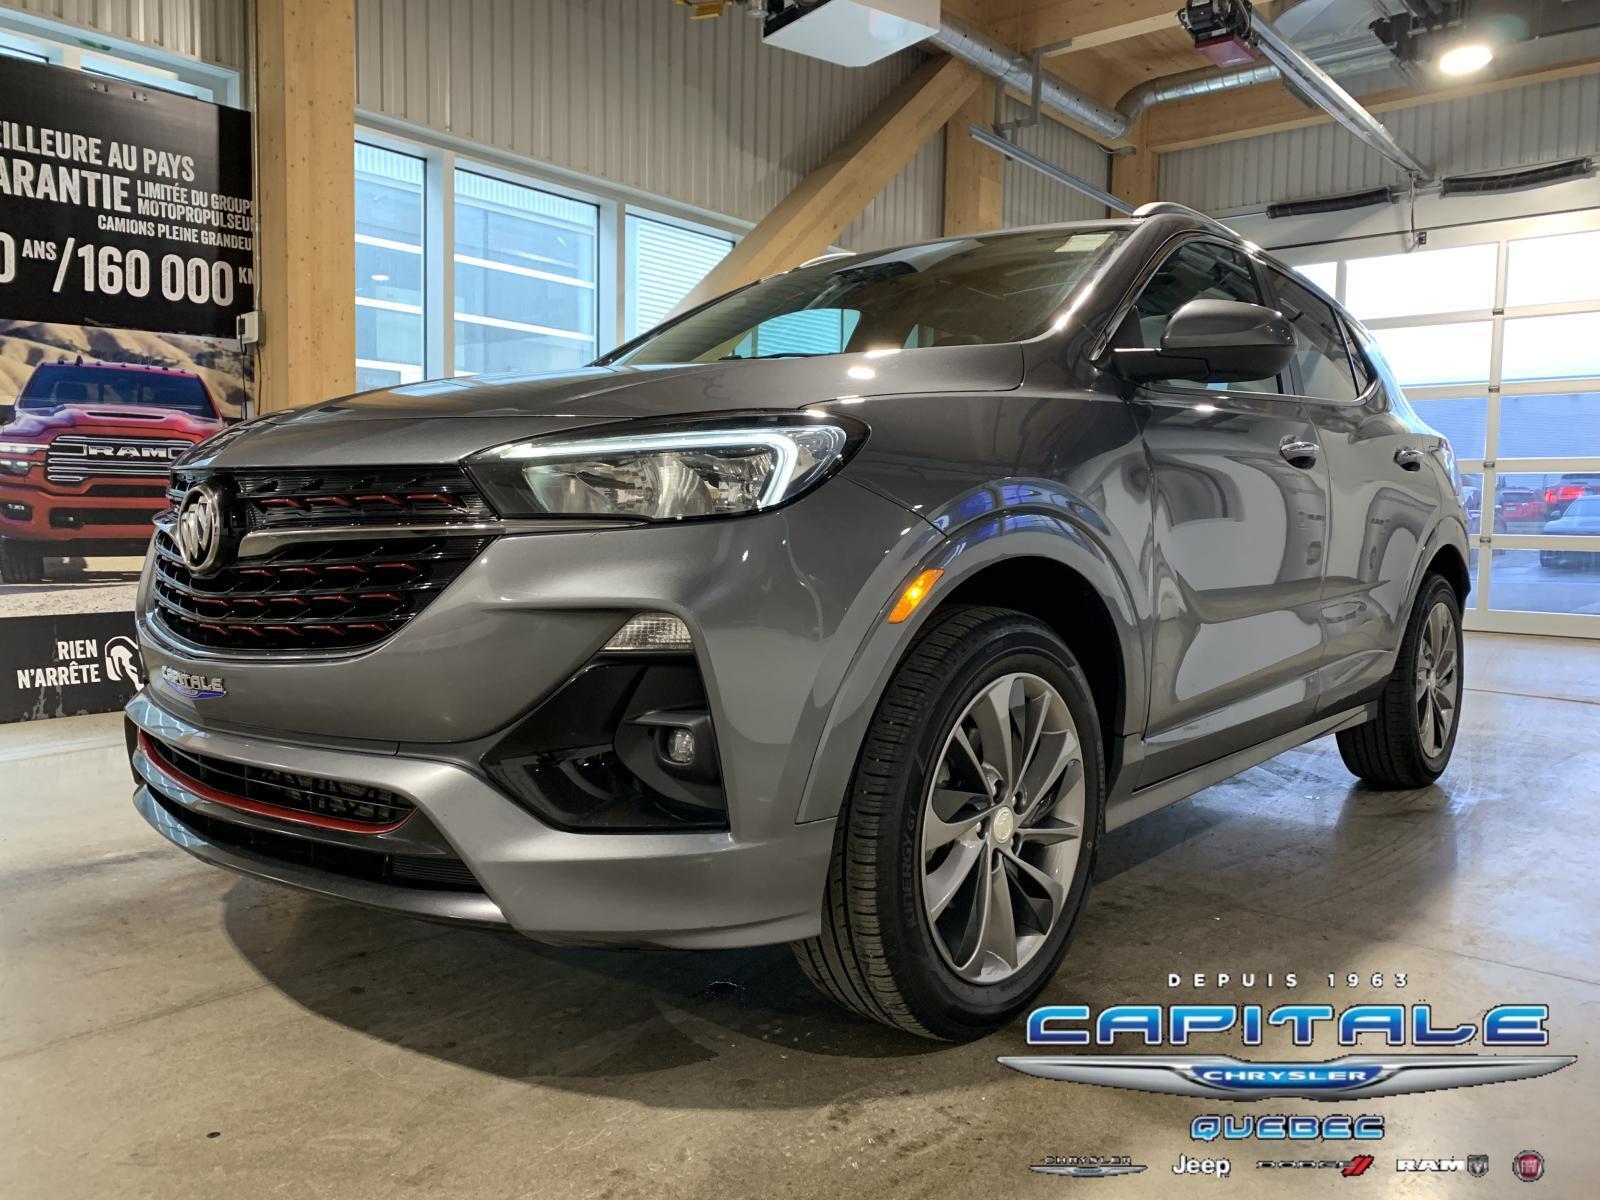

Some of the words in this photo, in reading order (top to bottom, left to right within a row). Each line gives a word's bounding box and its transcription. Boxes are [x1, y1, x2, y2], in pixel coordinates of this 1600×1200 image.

[108, 141, 137, 172] AU
[143, 147, 195, 182] PAYS
[137, 179, 188, 206] LIMITÉE
[191, 189, 208, 208] DU
[97, 214, 155, 238] CAMIONS
[157, 223, 199, 244] PLEINE
[22, 238, 57, 261] ANS
[161, 253, 234, 307] 000
[88, 445, 167, 458] RAM
[57, 639, 98, 661] RIEN
